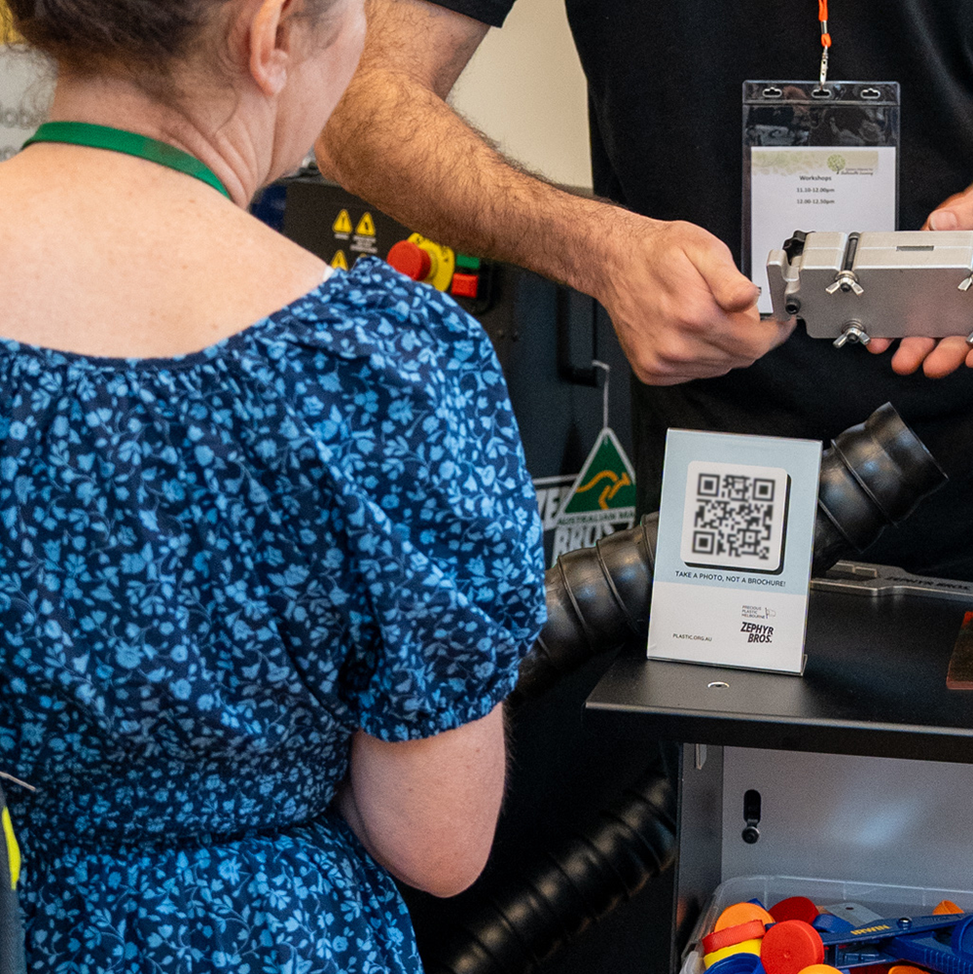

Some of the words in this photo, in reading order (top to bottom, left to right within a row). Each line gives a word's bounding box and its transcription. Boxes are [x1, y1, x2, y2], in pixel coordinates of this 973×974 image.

[675, 570, 692, 578] TAKE
[699, 573, 724, 583] PHOTO,
[747, 578, 786, 587] BROCHURE!
[740, 621, 774, 635] ZEPHYR
[672, 633, 713, 642] PLASTIC.ORG.AU
[747, 633, 773, 643] BROS.
